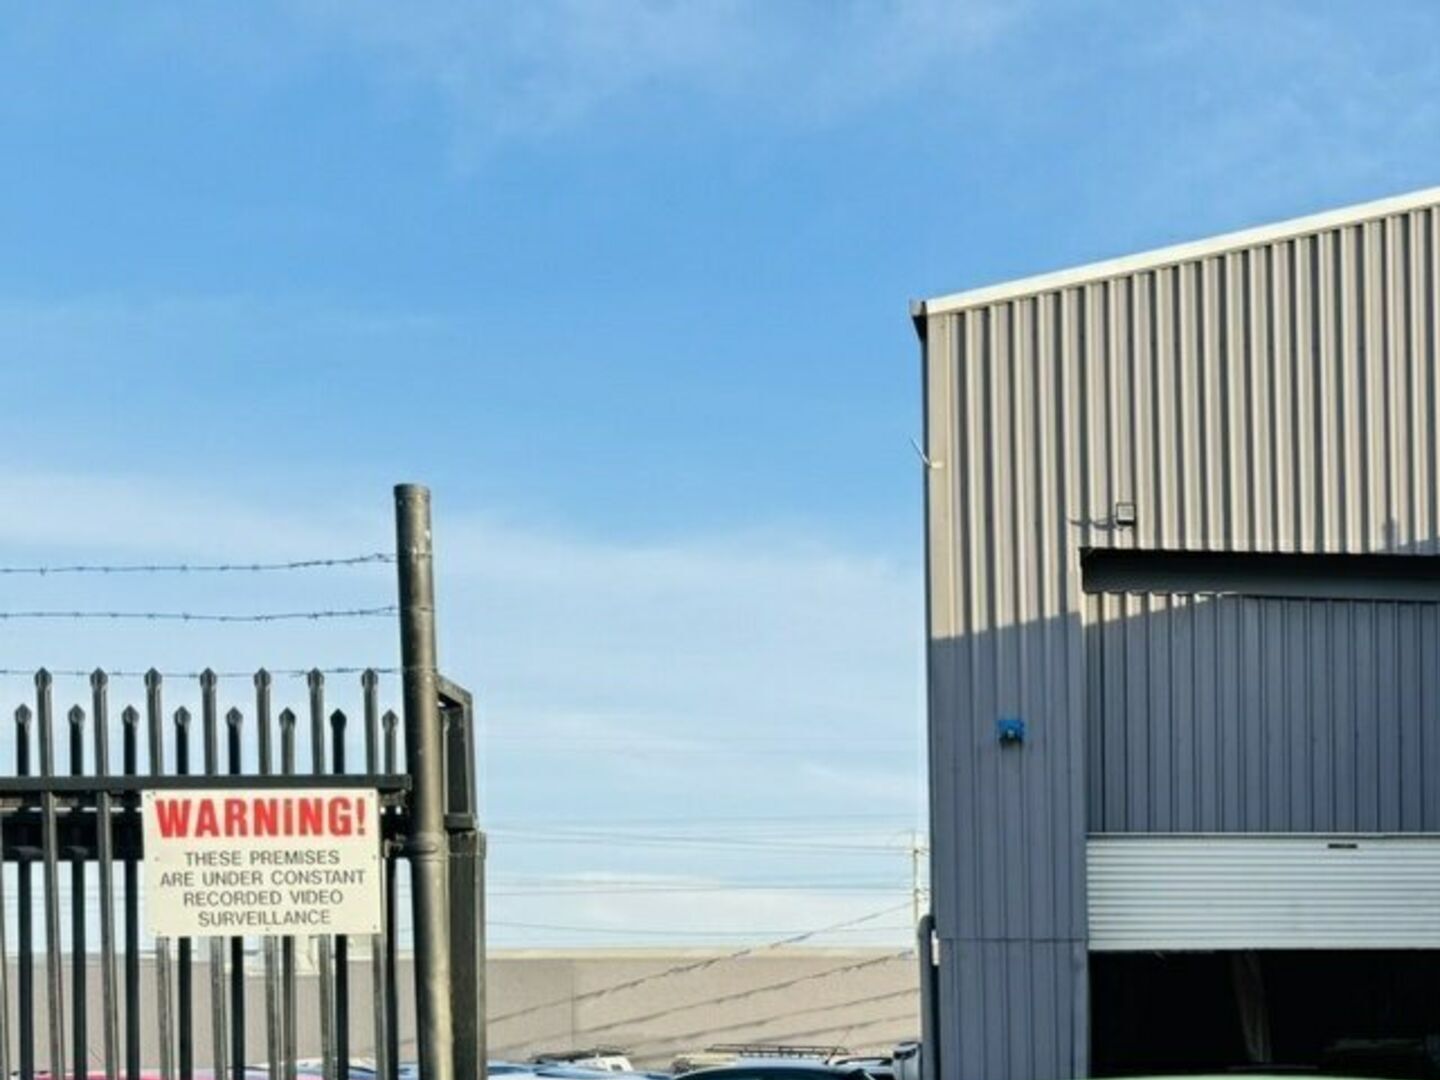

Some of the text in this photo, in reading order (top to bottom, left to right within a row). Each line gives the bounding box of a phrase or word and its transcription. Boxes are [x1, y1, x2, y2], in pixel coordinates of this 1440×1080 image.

[155, 797, 366, 838] WARNING!
[184, 850, 340, 866] THESE PREMISES
[160, 869, 365, 887] ARE UNDER CONSTANT
[184, 889, 343, 907] RECORDED VIDEO
[198, 909, 331, 927] SURVEILLANCE
